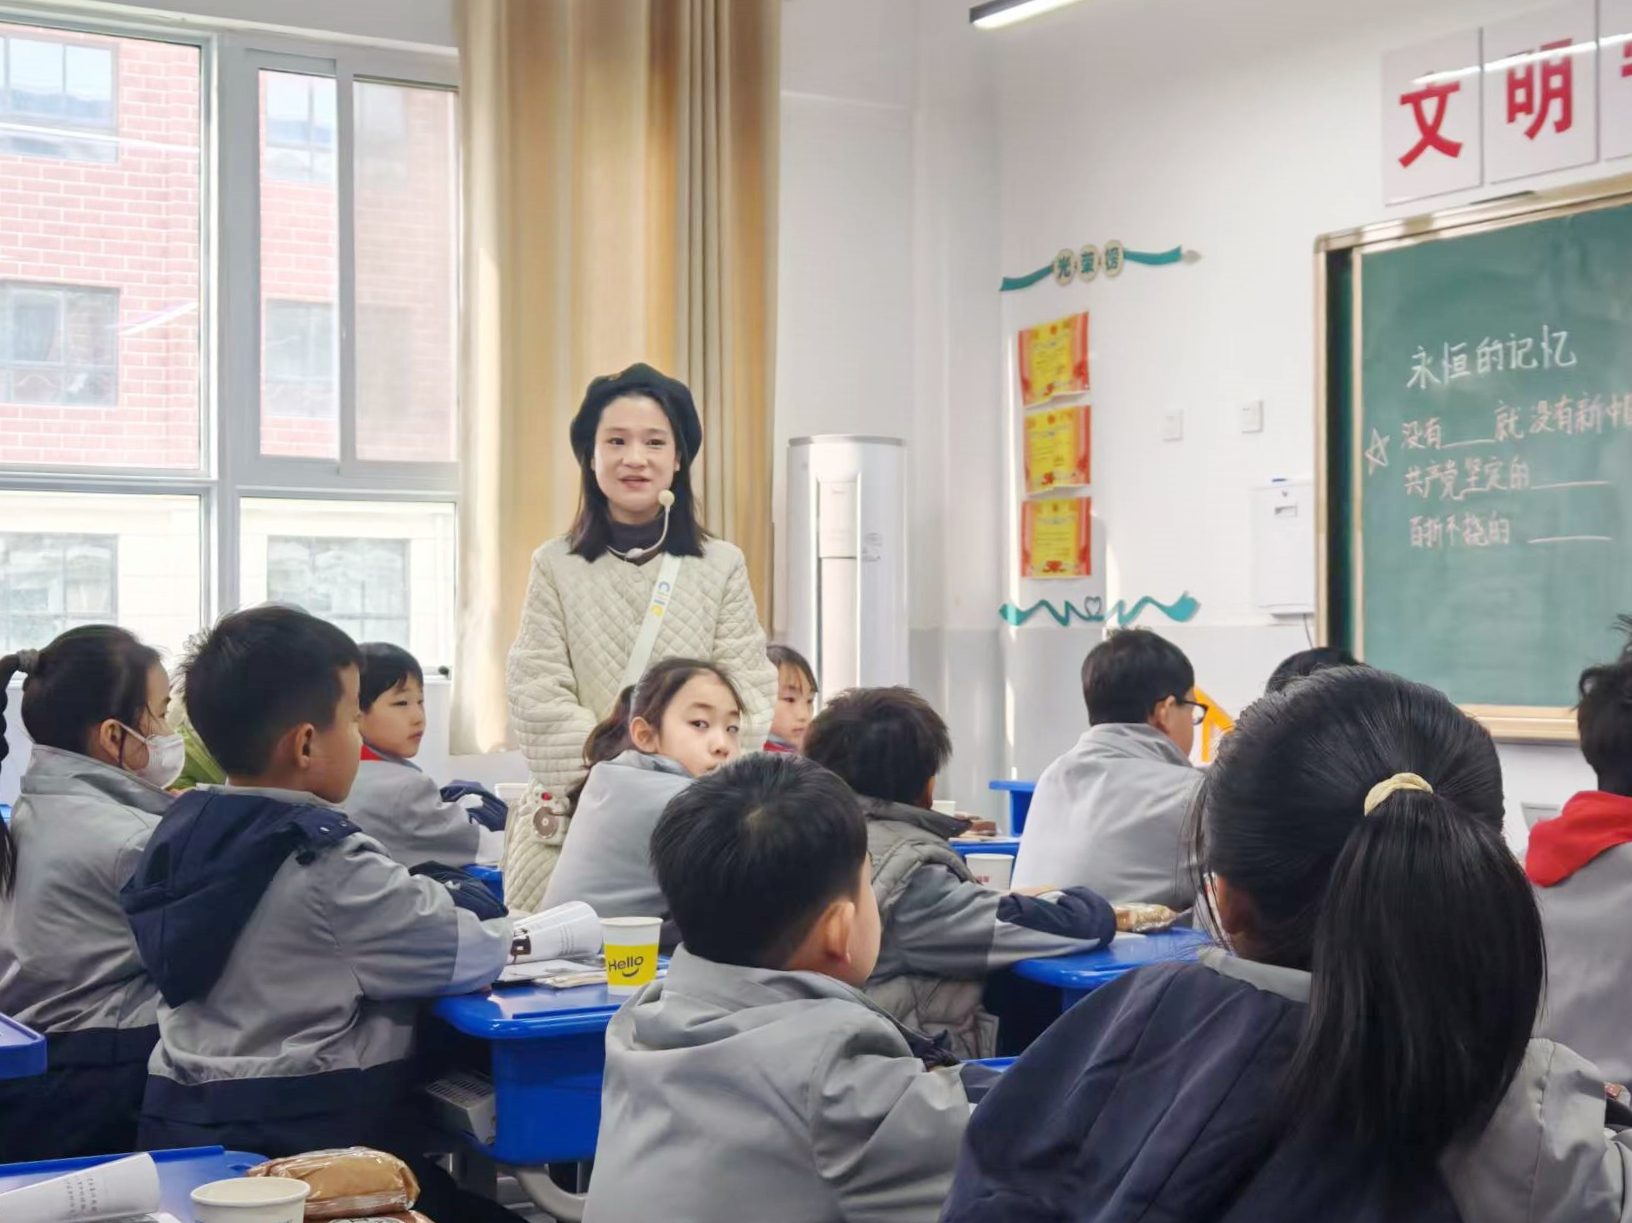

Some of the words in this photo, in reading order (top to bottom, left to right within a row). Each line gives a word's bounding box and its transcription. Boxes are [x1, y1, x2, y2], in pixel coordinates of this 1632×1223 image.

[1398, 37, 1632, 168] 文明
[1406, 324, 1578, 390] 永恒的记忆
[1402, 416, 1442, 450] 没有
[1403, 455, 1530, 500] 共产党坚定的
[608, 955, 644, 972] Hello
